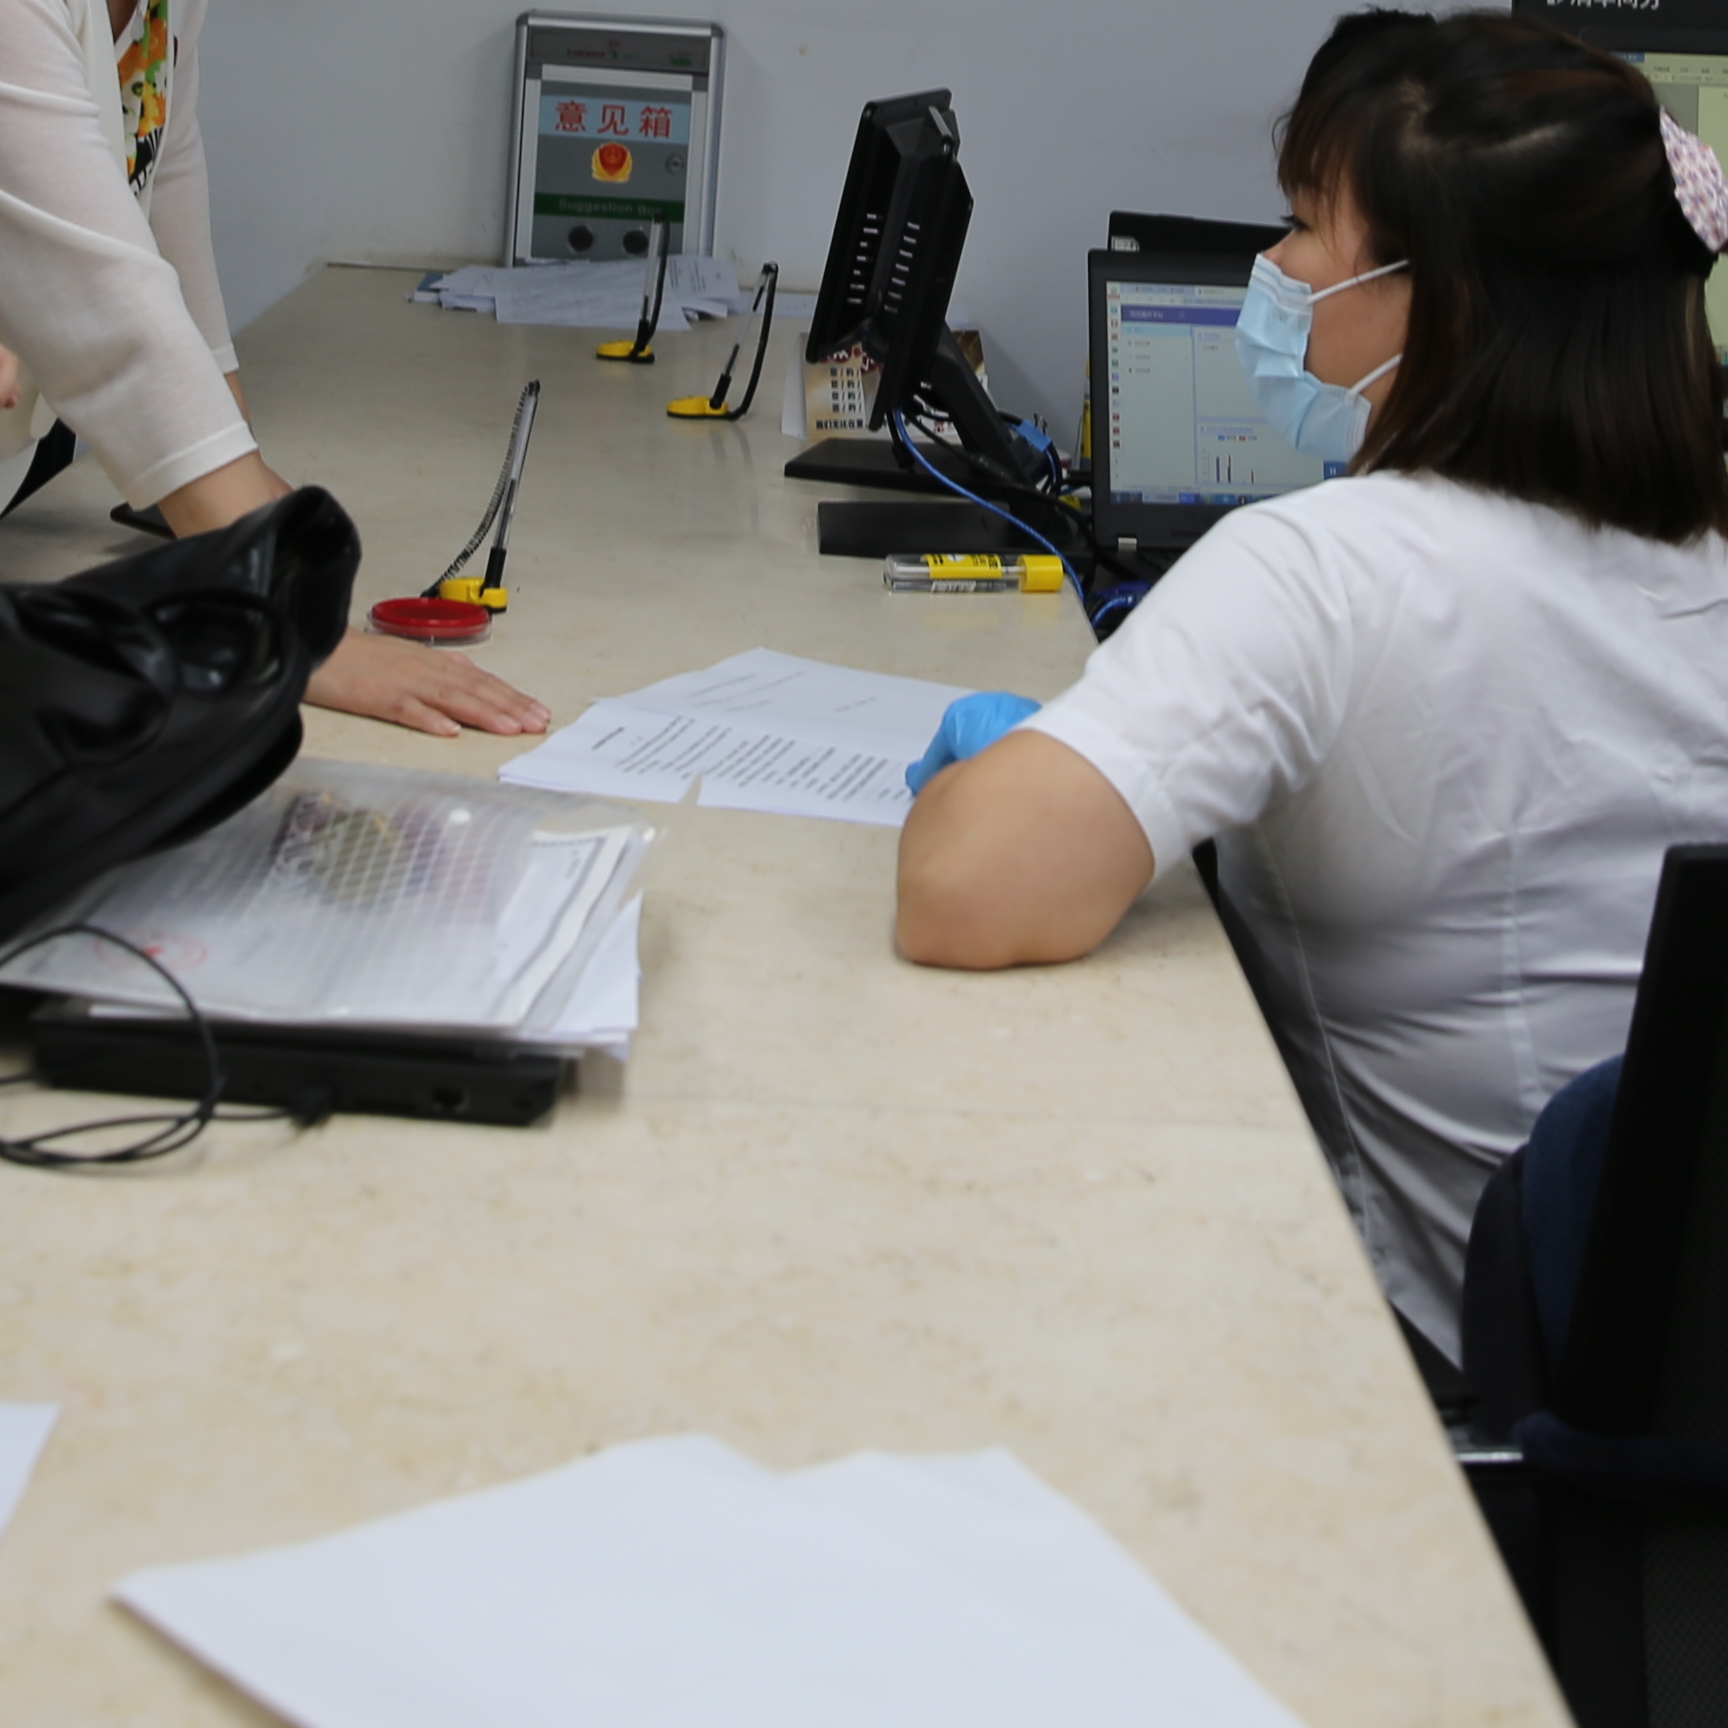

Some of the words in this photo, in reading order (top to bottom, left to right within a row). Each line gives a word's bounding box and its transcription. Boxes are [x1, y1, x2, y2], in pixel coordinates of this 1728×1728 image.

[554, 99, 673, 140] 意见箱
[558, 197, 633, 215] Suggestion
